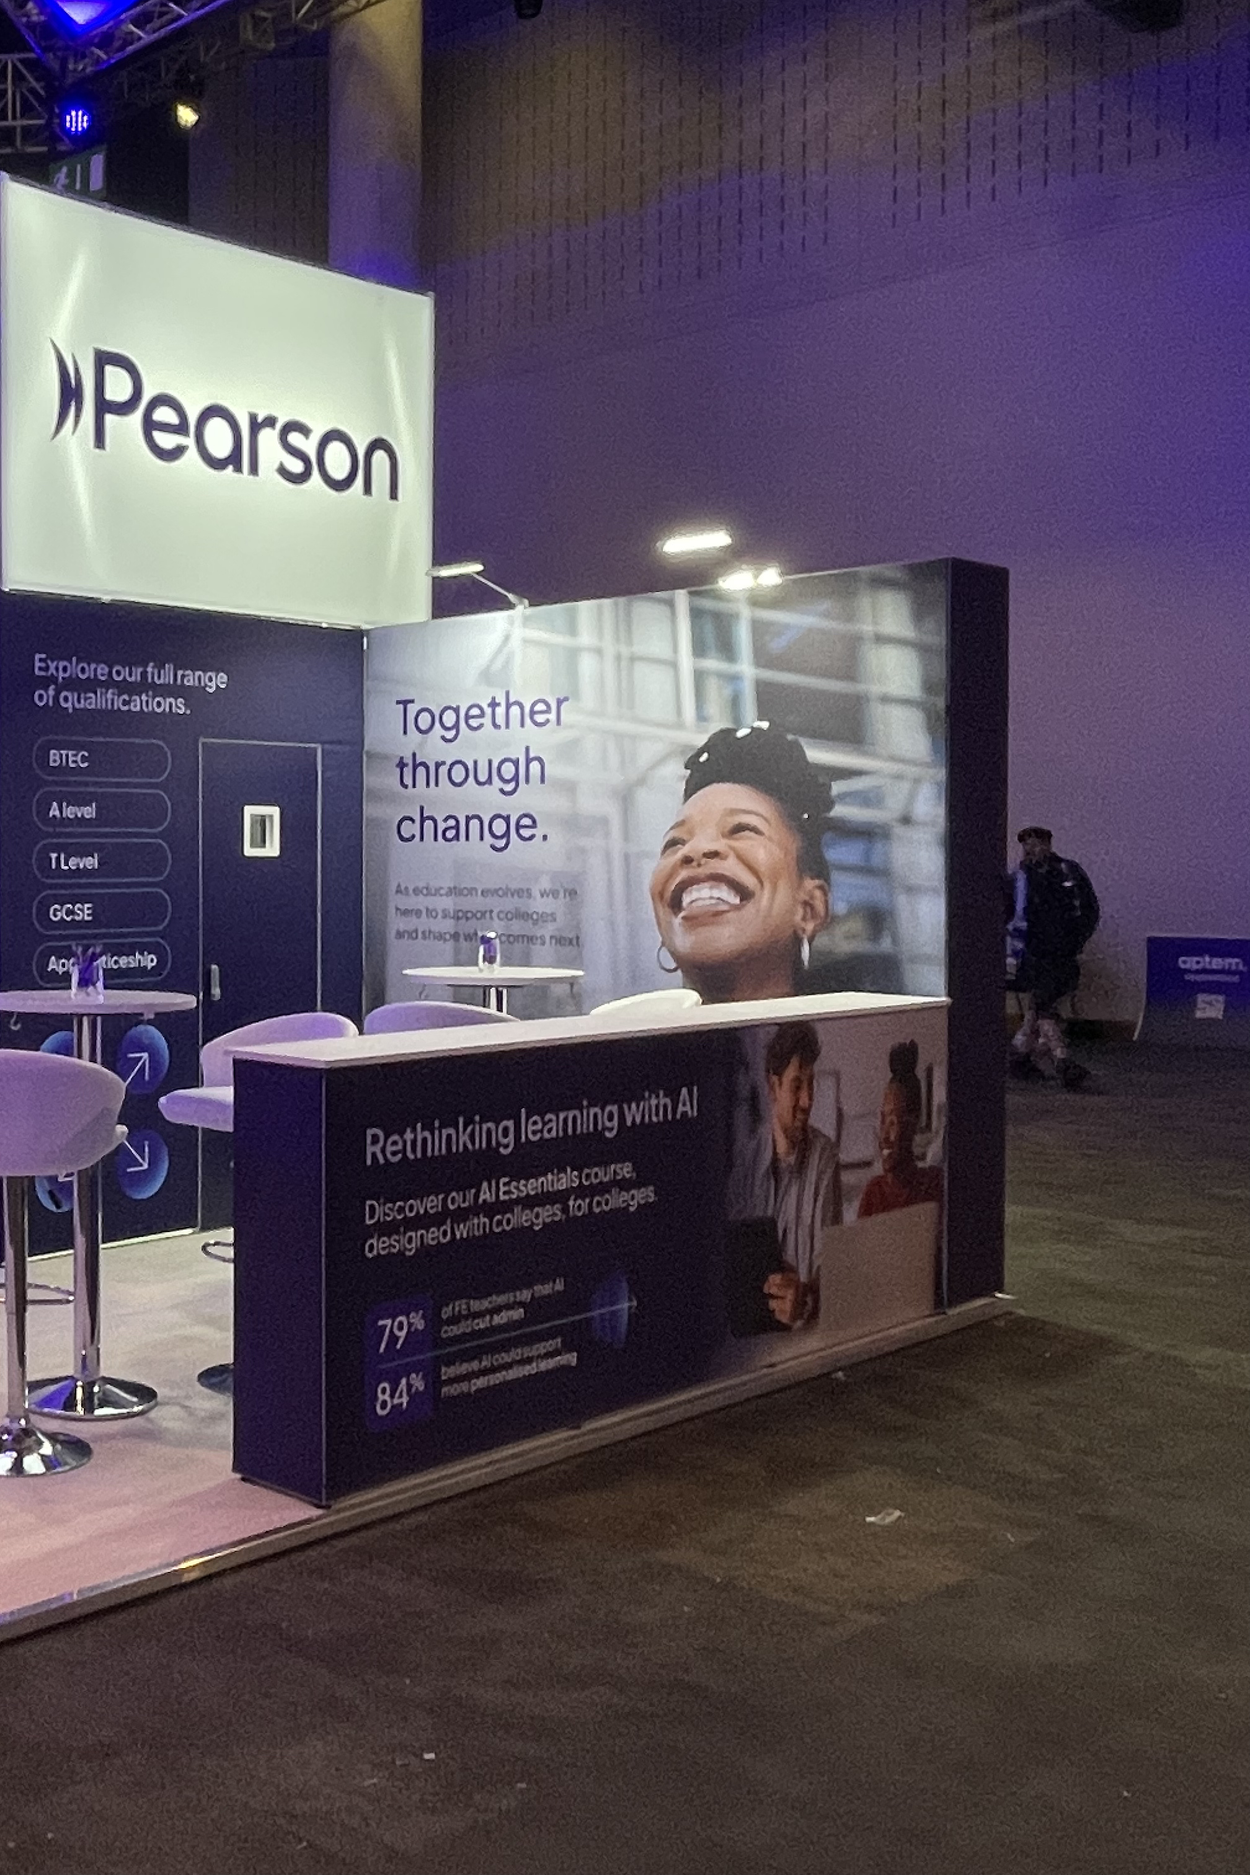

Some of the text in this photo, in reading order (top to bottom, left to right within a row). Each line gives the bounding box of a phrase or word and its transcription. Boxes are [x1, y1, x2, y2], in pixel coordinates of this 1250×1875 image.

[92, 346, 400, 502] Pearson
[34, 653, 228, 693] Explore our full range
[34, 685, 191, 715] of qualifications.
[396, 690, 569, 743] Together
[49, 750, 90, 768] BTEC
[396, 745, 546, 796] through
[49, 801, 96, 819] A level
[396, 805, 548, 852] change.
[49, 853, 99, 870] T Level
[395, 883, 410, 896] As
[412, 883, 478, 897] education
[49, 903, 94, 922] GCSE
[395, 905, 557, 927] here to support colleges
[395, 927, 418, 941] and
[421, 927, 460, 944] shape
[498, 932, 547, 947] comes
[47, 949, 158, 976] Appticeship
[365, 1084, 699, 1167] Rethinking learning with AI
[364, 1160, 637, 1226] Discover our AI Essentials course,
[364, 1183, 659, 1259] designed with colleges, for colleges.
[454, 1299, 469, 1316] FE
[472, 1313, 491, 1331] cut
[377, 1309, 426, 1354] 79%
[375, 1371, 426, 1417] 84%
